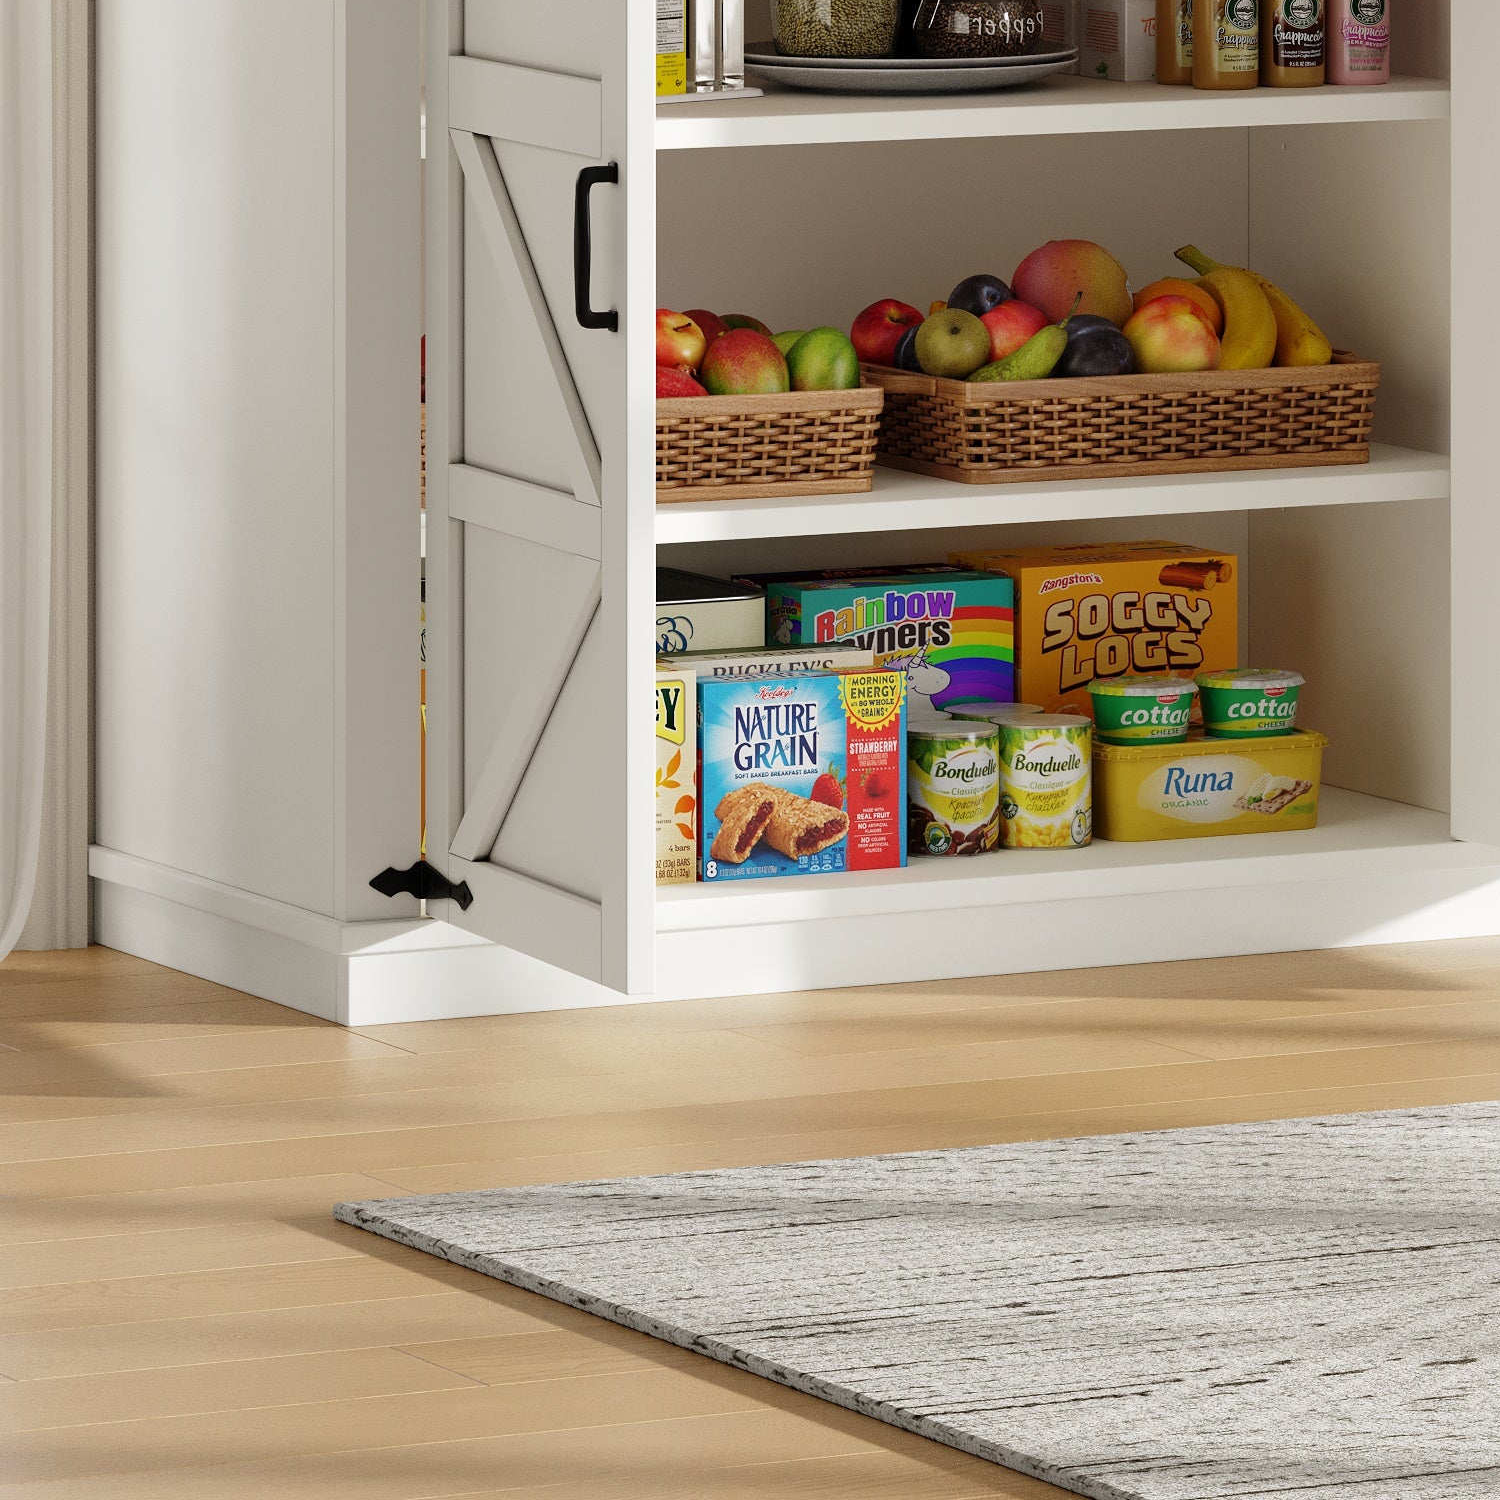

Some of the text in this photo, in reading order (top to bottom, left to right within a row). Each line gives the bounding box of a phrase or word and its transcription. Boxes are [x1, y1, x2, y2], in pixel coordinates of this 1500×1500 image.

[1042, 573, 1102, 593] Rangston's
[816, 592, 954, 643] Rainbow
[1042, 592, 1212, 654] SOGGY
[1059, 631, 1204, 694] LOGS
[852, 675, 894, 686] MORNING
[850, 684, 896, 699] ENERGY
[869, 698, 894, 706] WHOLE
[860, 707, 885, 718] GRAINS
[735, 704, 816, 745] NATURE
[1150, 727, 1180, 736] CHEESE
[1258, 720, 1286, 728] CHEESE
[734, 732, 817, 771] GRAIN
[850, 740, 898, 754] STRAWBERRY
[934, 758, 996, 782] Bonduelle
[1014, 753, 1080, 776] Bonduelle
[1030, 780, 1064, 790] Classique
[1164, 767, 1234, 798] Runa
[1026, 788, 1069, 803] Кукуруза
[1162, 799, 1209, 809] ORGANIC
[675, 844, 691, 852] bars
[663, 860, 675, 869] (33g)
[677, 858, 691, 866] BARS
[706, 861, 718, 878] 8
[666, 870, 674, 878] OZ
[674, 868, 691, 878] (132g)
